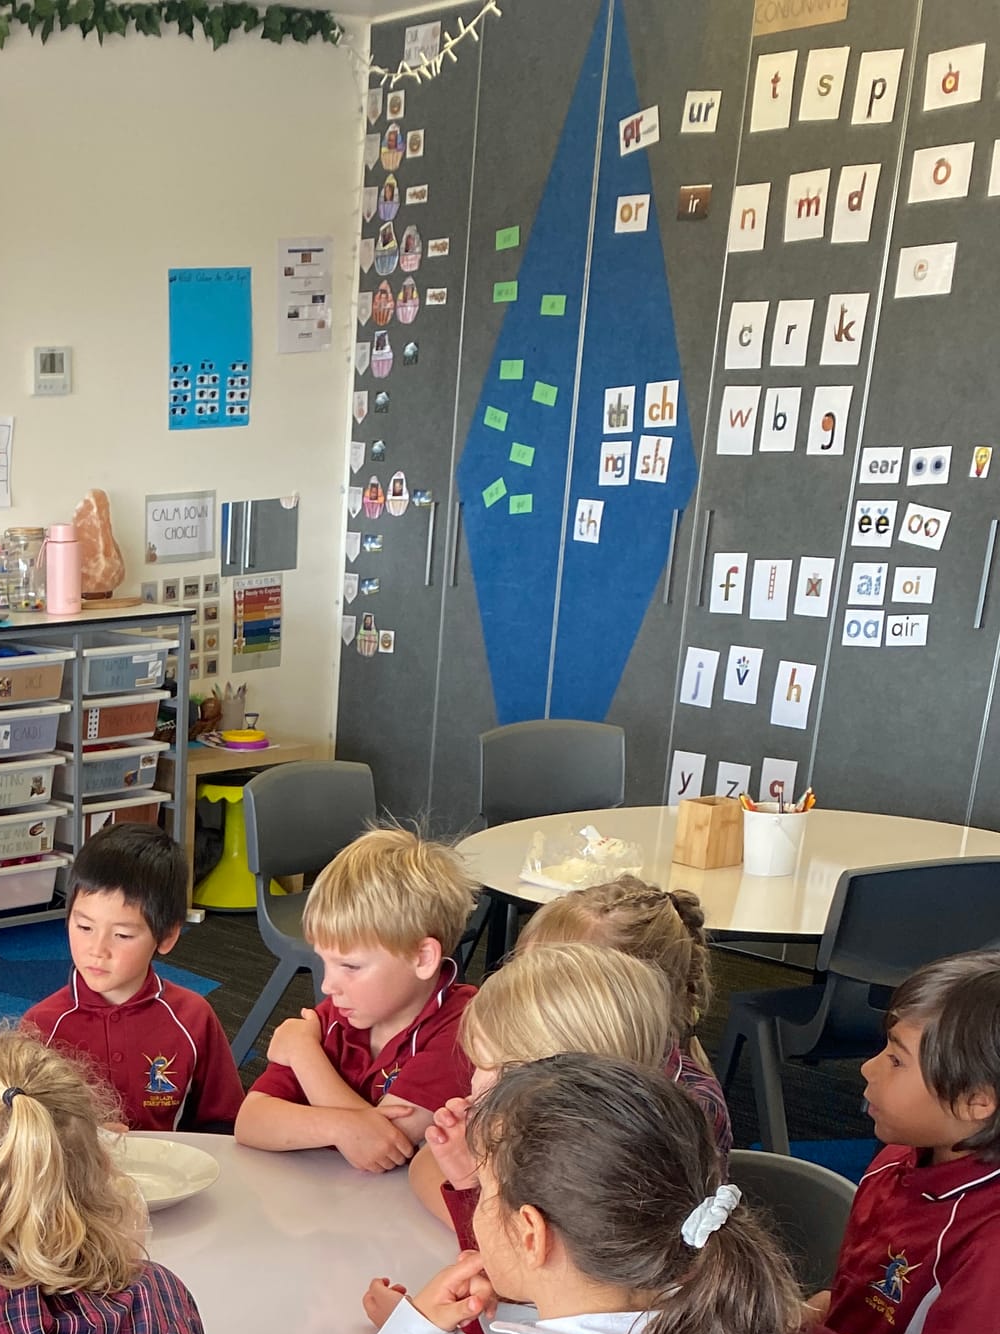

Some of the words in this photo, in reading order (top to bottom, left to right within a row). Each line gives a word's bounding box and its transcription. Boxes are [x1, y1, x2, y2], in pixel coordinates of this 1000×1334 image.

[770, 70, 781, 99] t
[817, 74, 834, 97] s
[865, 77, 887, 118] p
[688, 101, 715, 123] ur
[620, 202, 644, 223] or
[740, 207, 756, 230] n
[796, 193, 821, 219] m
[847, 171, 867, 211] d
[785, 324, 797, 345] r
[833, 303, 856, 342] k
[648, 385, 673, 421] ch
[729, 407, 753, 428] w
[772, 393, 787, 431] b
[605, 452, 625, 479] ng
[640, 438, 665, 476] sh
[868, 459, 899, 474] ear
[152, 507, 181, 521] CALM
[719, 565, 739, 601] f
[902, 575, 921, 595] oi
[891, 616, 920, 637] air
[786, 668, 802, 703] h
[678, 771, 693, 796] y
